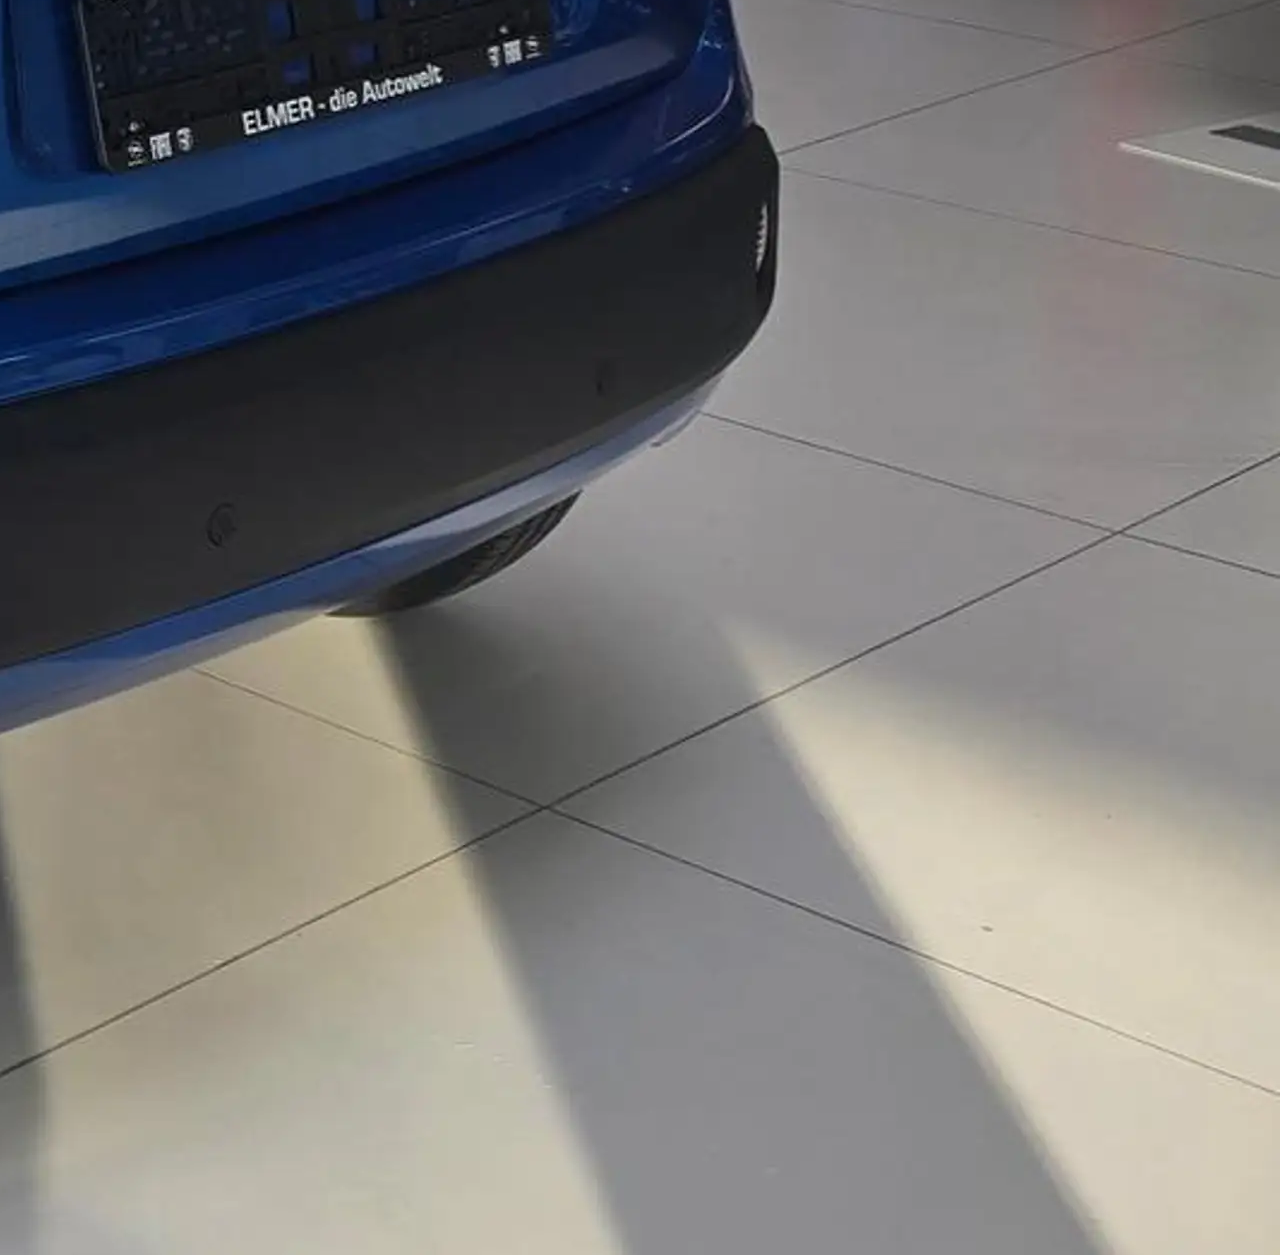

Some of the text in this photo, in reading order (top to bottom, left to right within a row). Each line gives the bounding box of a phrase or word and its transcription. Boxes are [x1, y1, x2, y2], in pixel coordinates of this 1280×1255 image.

[241, 95, 316, 136] ELMER
[329, 86, 359, 113] die
[361, 62, 444, 105] Autowelt
